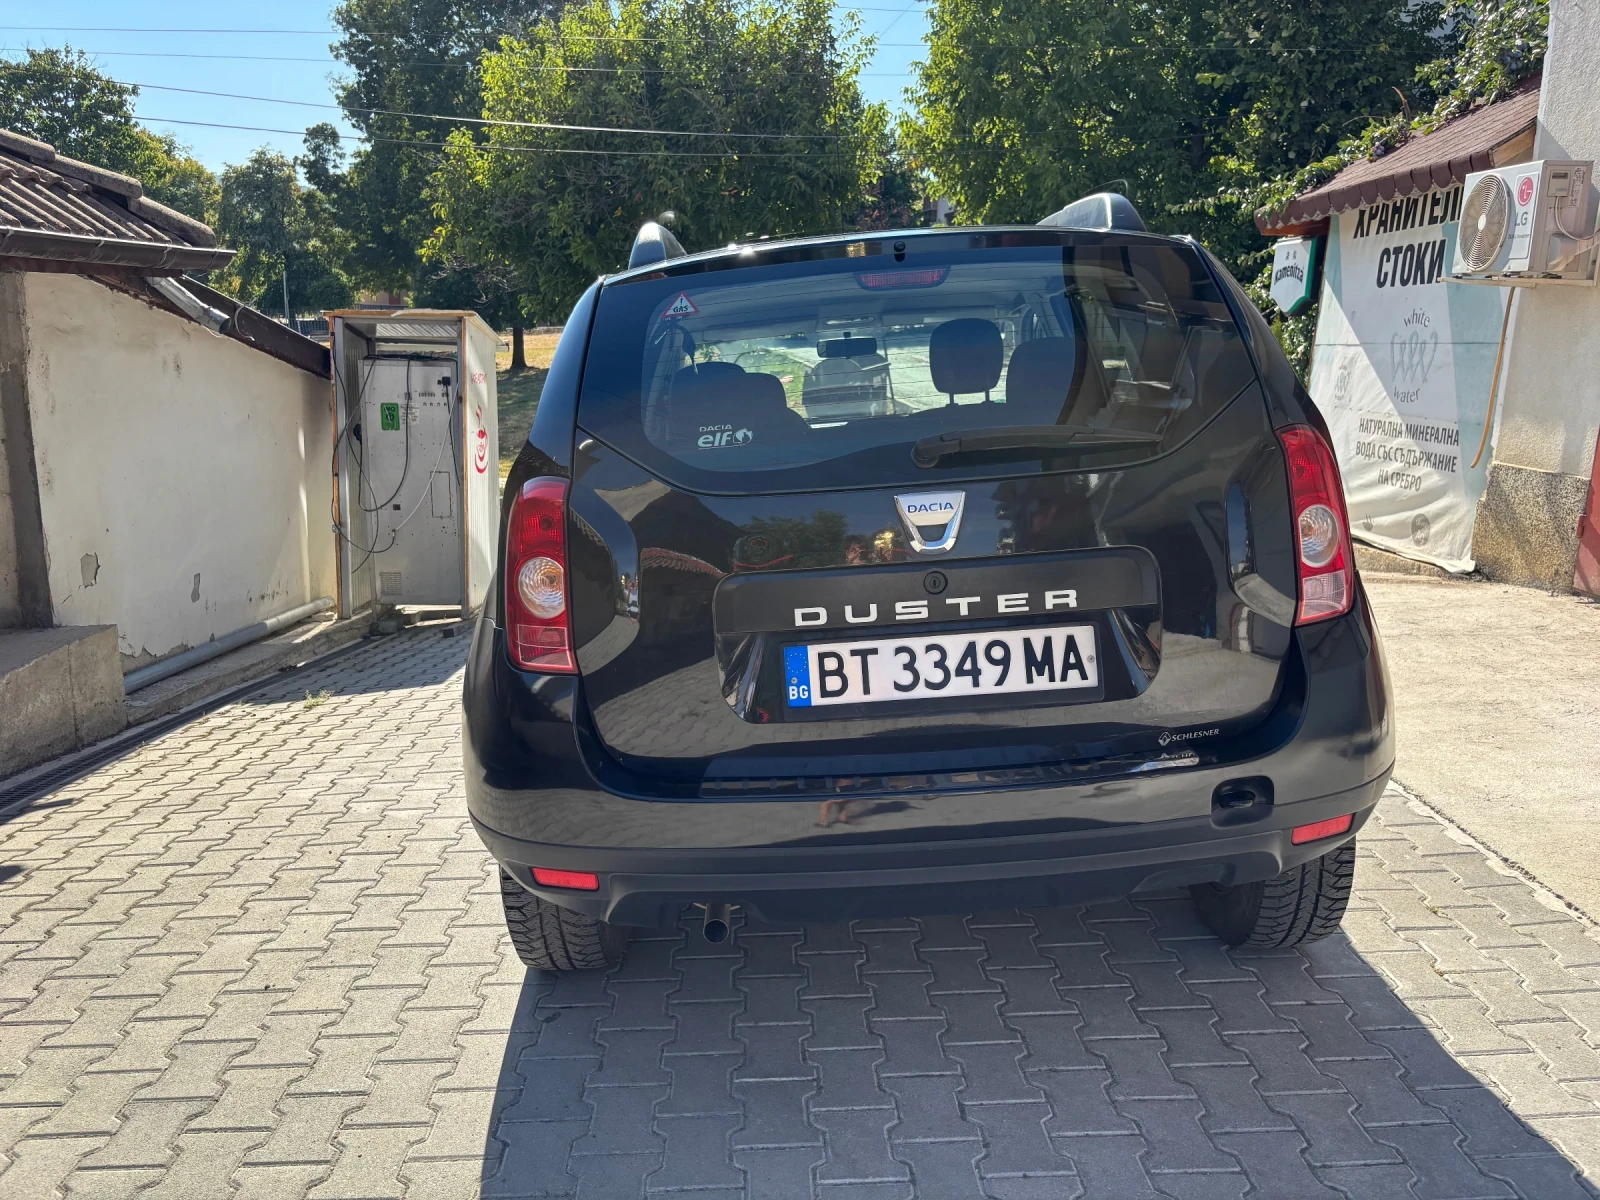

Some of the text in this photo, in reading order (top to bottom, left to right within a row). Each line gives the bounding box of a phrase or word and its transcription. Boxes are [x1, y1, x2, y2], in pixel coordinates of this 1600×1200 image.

[1514, 211, 1529, 226] LG
[1376, 239, 1447, 288] СТОКИ
[1403, 308, 1430, 328] white
[1393, 386, 1420, 403] water
[700, 424, 732, 432] DACIA
[1359, 418, 1459, 446] НАТУРАЛНА МИНЕРАЛНА
[698, 431, 732, 447] elf
[1356, 441, 1457, 473] ВОДА СЪС СЪДЪРЖАНИЕ
[1378, 469, 1422, 492] НА СРЕБРО
[907, 502, 954, 513] DACIA
[794, 589, 1078, 626] DUSTER
[818, 635, 1089, 698] BT 3349 MA
[789, 685, 809, 700] BG
[1171, 729, 1220, 741] SCHLESNER
